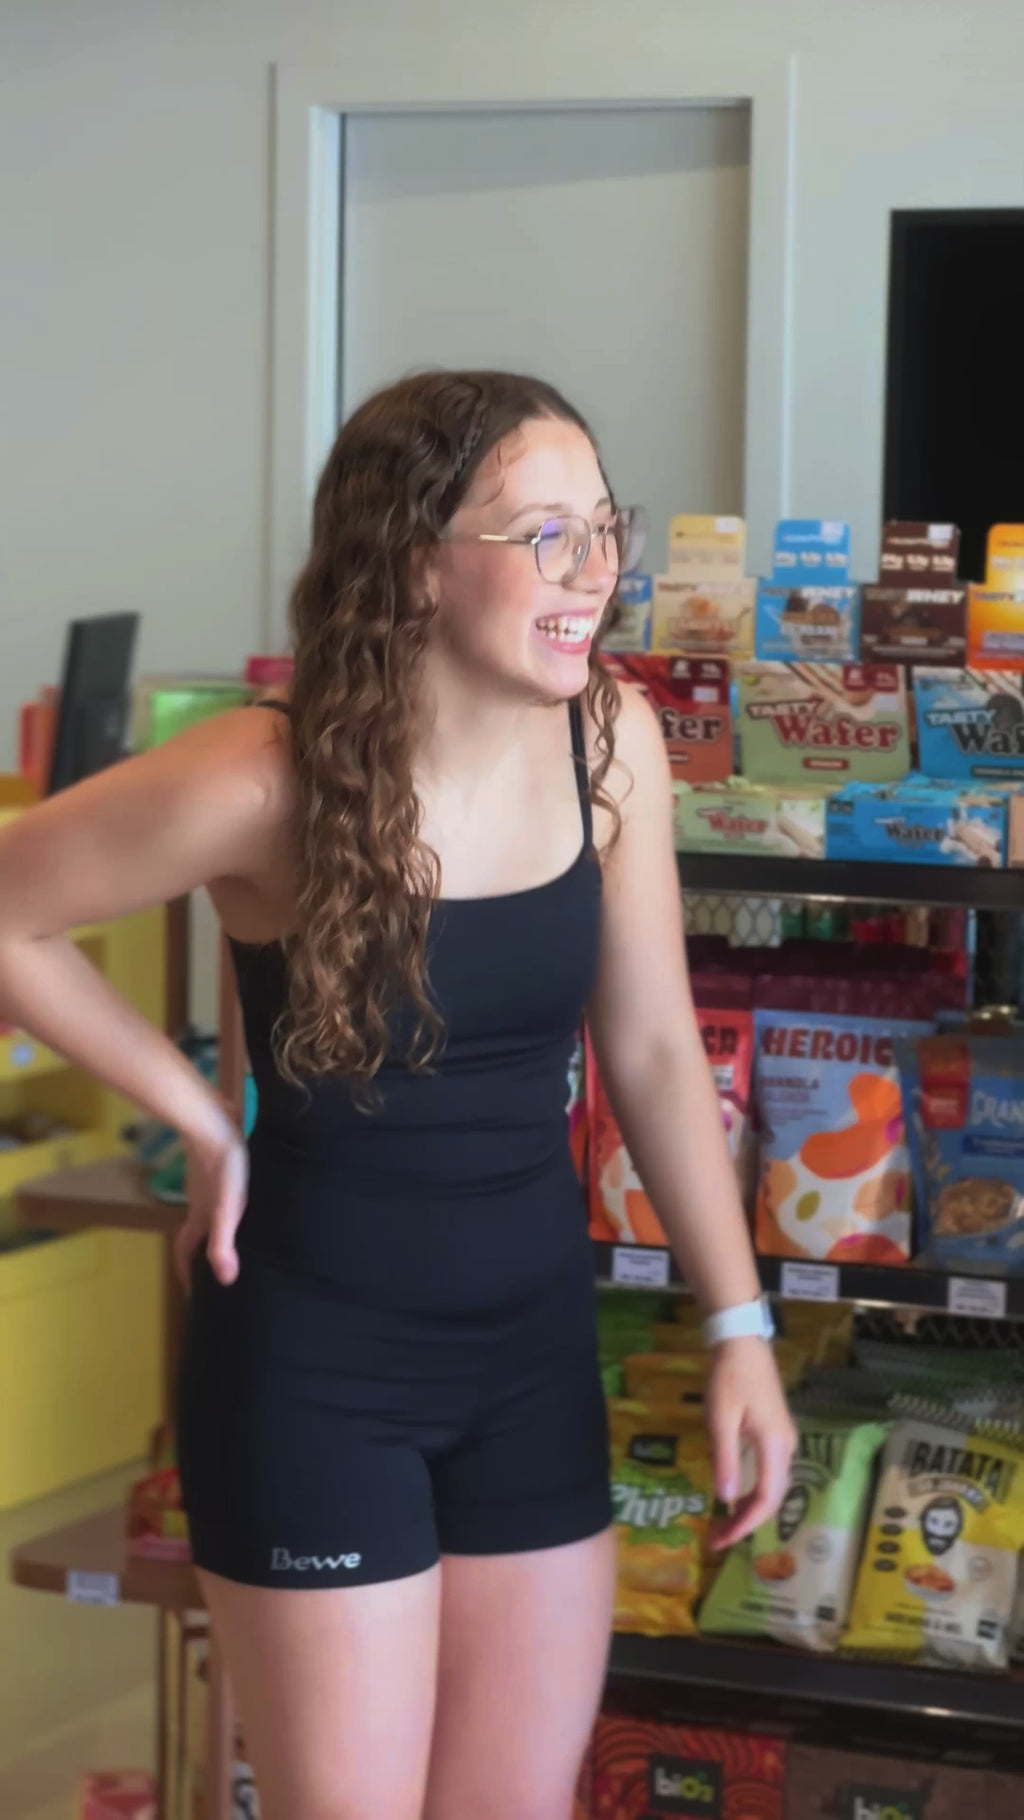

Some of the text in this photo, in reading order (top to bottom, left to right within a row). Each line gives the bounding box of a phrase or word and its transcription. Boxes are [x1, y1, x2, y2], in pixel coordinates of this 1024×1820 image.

[660, 708, 722, 741] fer
[773, 713, 898, 748] Wafer
[926, 709, 997, 726] TASTY
[761, 1027, 894, 1067] HEROIC
[911, 1441, 1004, 1499] BATATA
[271, 1547, 362, 1571] Bewe
